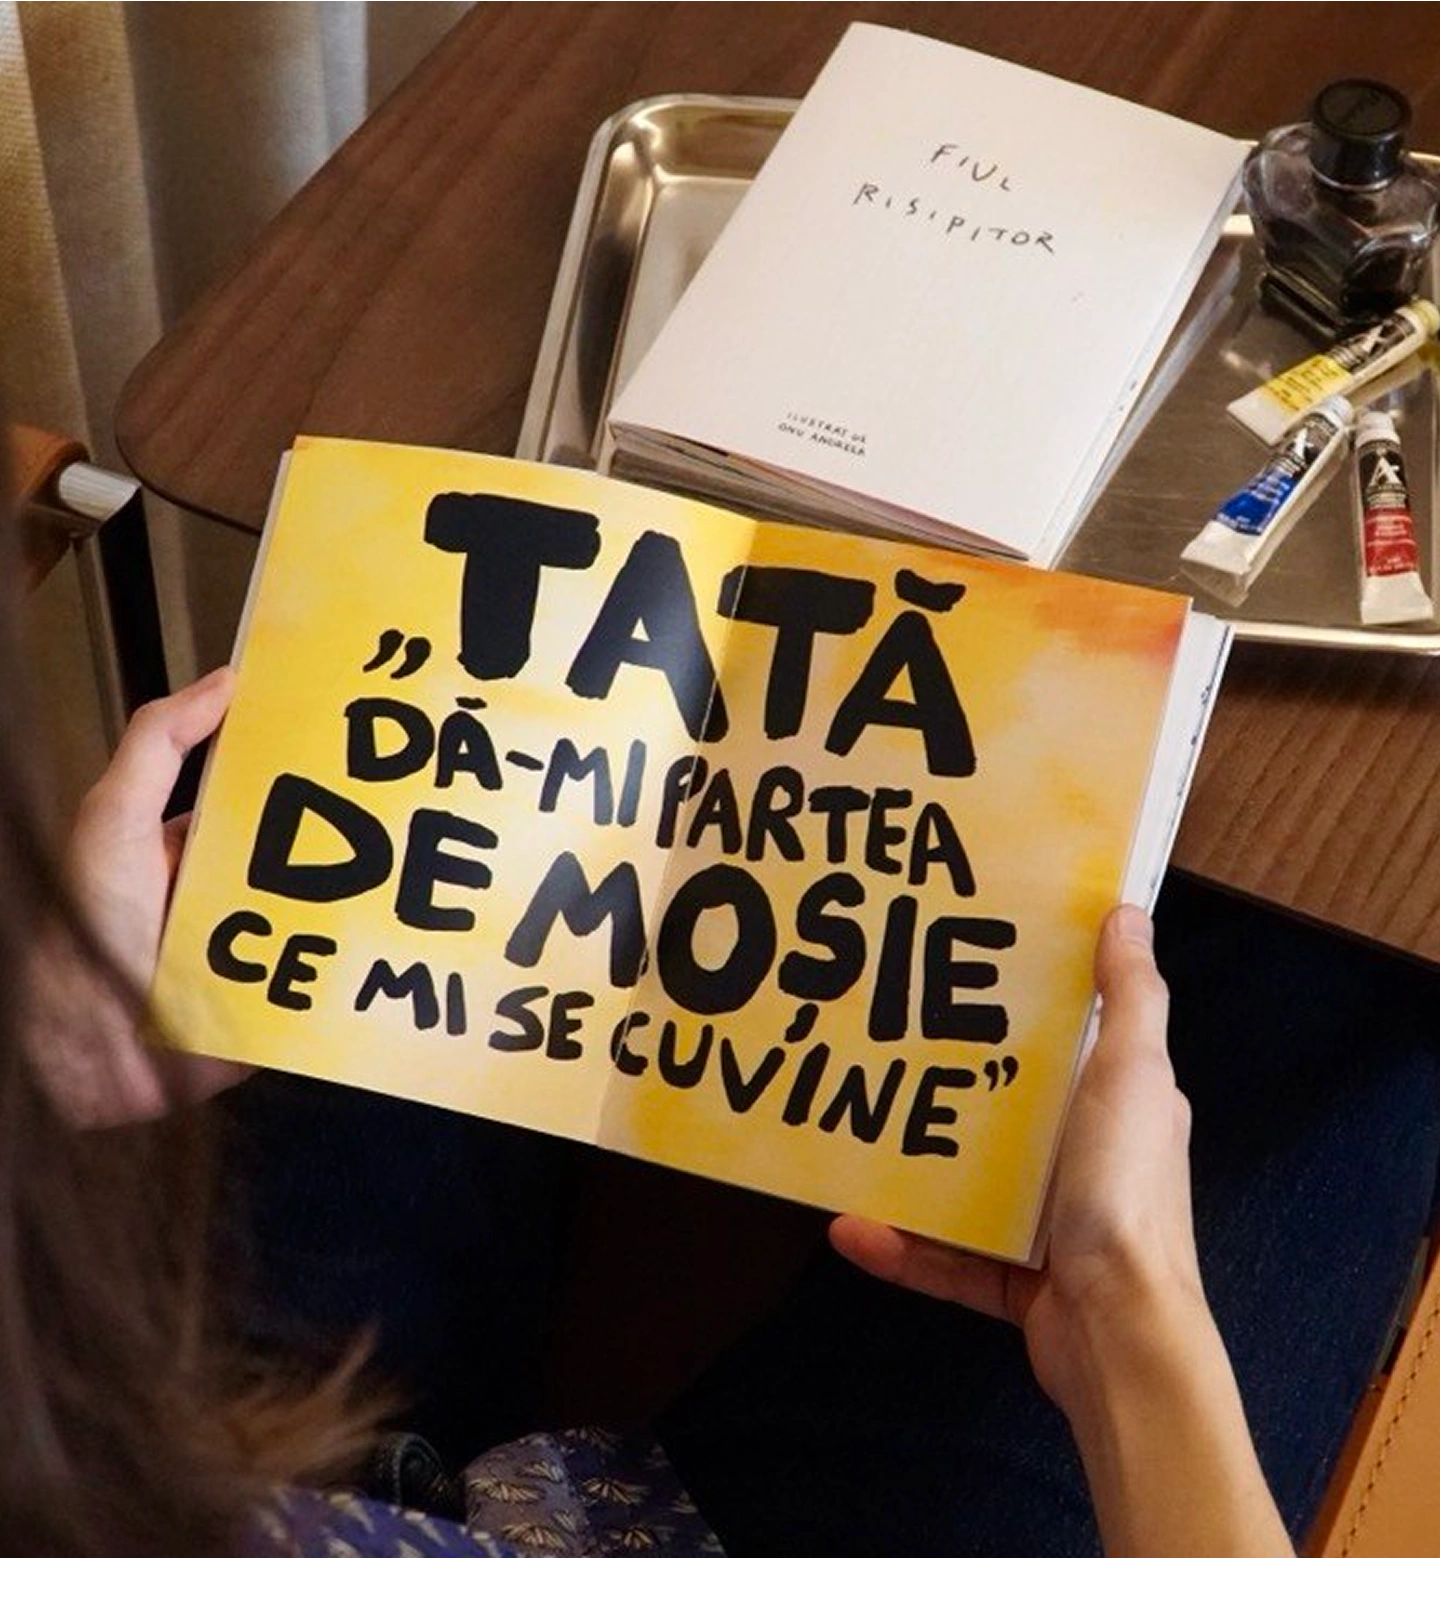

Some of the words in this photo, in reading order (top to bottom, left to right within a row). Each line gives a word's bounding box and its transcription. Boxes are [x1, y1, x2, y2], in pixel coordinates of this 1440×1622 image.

[852, 182, 1055, 256] RISIPITOR
[930, 143, 1011, 192] FIUL
[246, 772, 498, 933] DE
[343, 695, 646, 828] DĂ-MI
[655, 754, 976, 897] PARTEA
[206, 910, 338, 1011] CE
[354, 958, 468, 1037] MI
[489, 984, 595, 1061] SE
